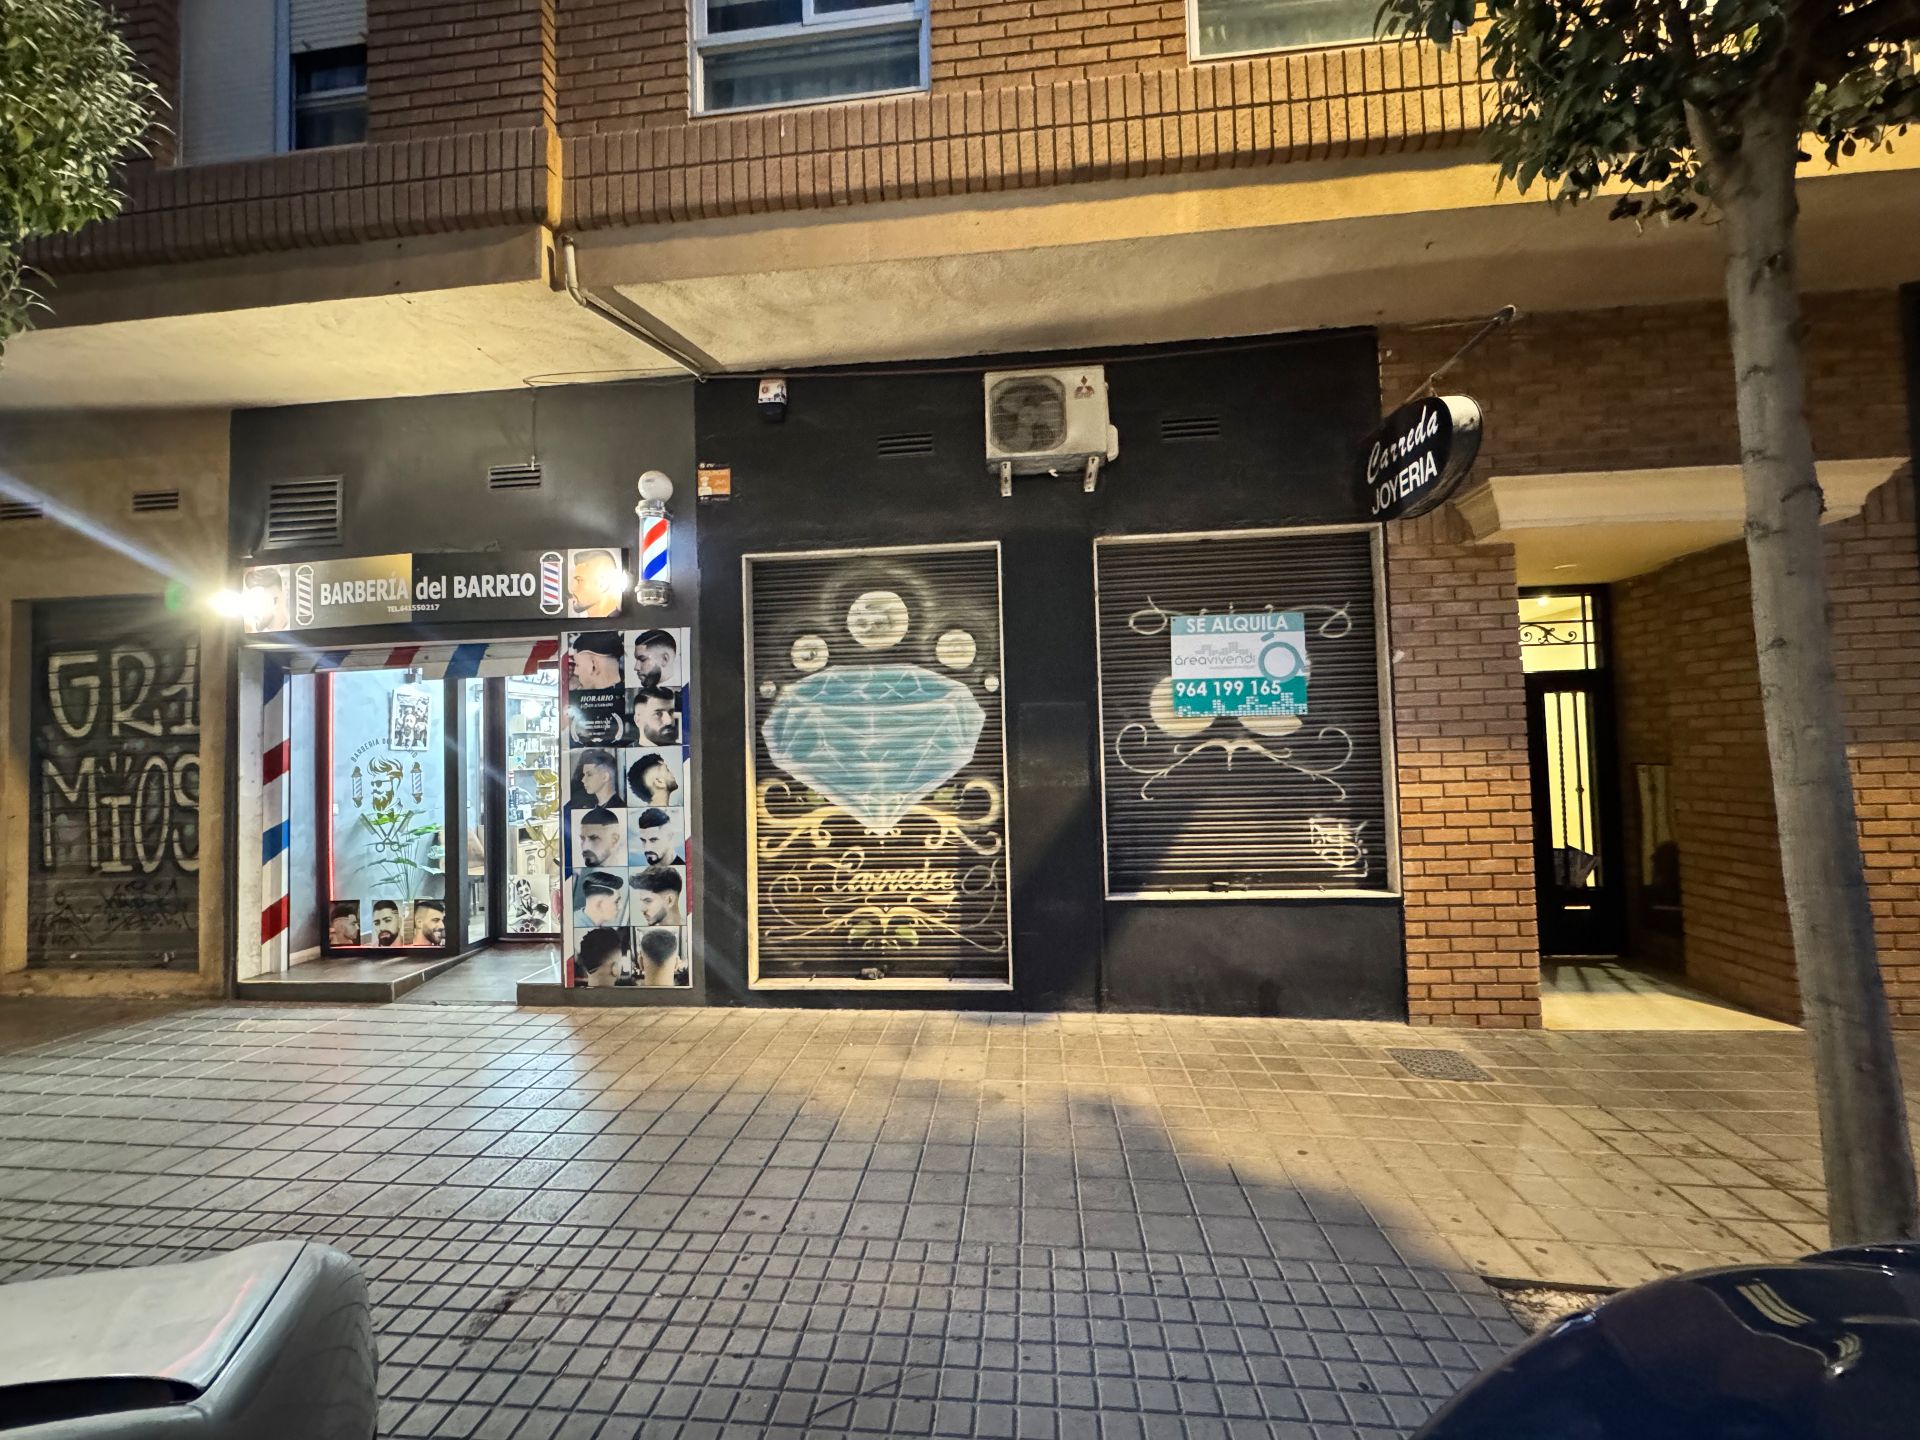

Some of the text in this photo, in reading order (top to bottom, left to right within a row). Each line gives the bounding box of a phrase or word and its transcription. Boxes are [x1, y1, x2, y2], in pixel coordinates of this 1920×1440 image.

[1367, 404, 1439, 485] Carreda
[1371, 450, 1438, 515] JOYERIA
[320, 570, 537, 605] BARBERÍA del BARRIO
[1186, 614, 1288, 632] SE ALQUILA
[1176, 680, 1281, 697] 964 199 165
